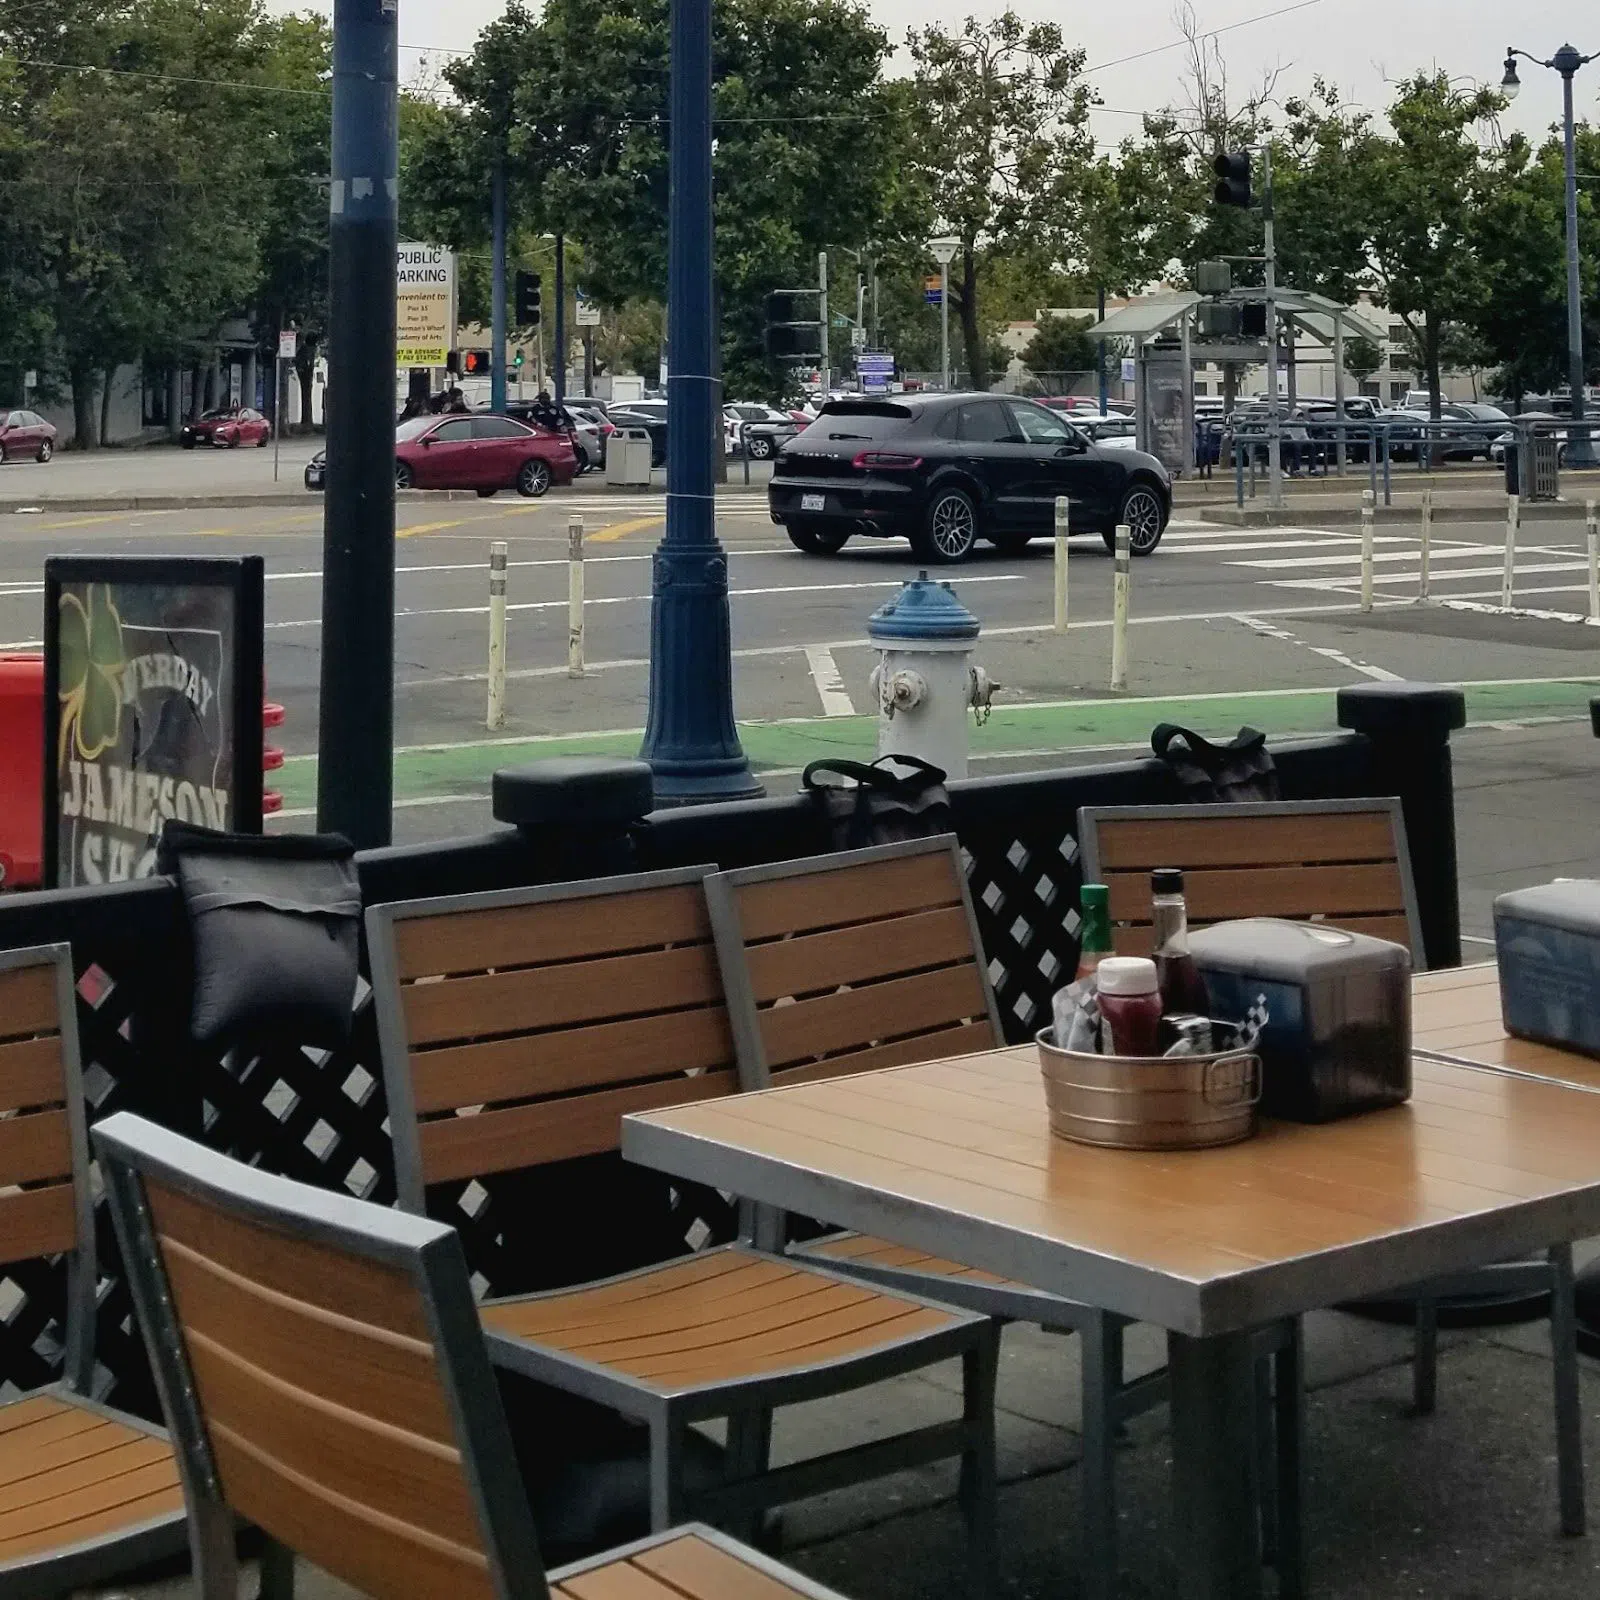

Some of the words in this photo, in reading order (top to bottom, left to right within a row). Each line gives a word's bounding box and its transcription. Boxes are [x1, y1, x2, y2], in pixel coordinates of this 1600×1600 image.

[397, 252, 441, 264] PUBLIC
[397, 269, 447, 282] ARKING
[63, 761, 228, 834] JAMESON
